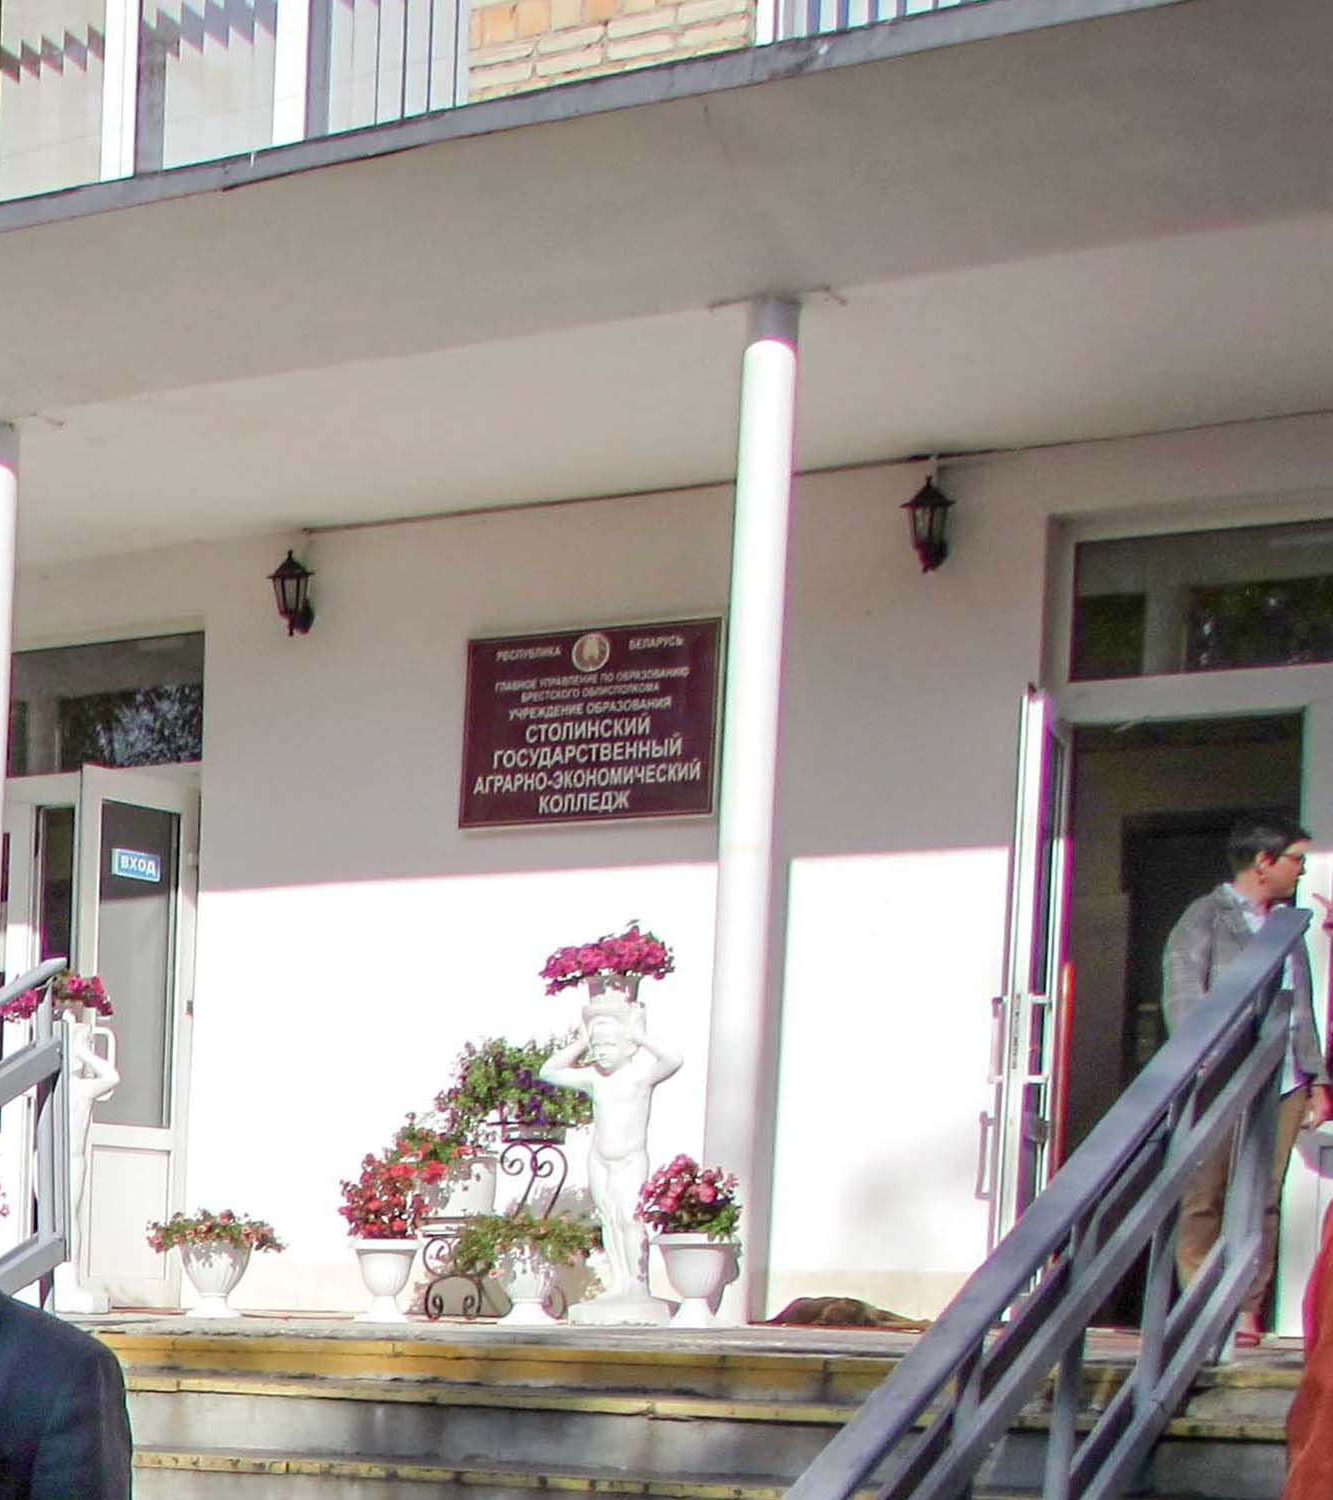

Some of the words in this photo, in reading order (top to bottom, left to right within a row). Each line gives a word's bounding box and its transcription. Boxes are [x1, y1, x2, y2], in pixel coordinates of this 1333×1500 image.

[495, 646, 562, 662] РЕСПУБЛИКА
[629, 637, 685, 651] БЕЛАРУСЬ
[600, 672, 614, 683] ПО
[508, 702, 584, 721] УЧРЕЖДЕНИЕ
[586, 695, 672, 715] ОБРАЗОВАНИЯ
[521, 689, 580, 703] БРЕСТСКОГО
[525, 711, 650, 743] СТОЛИНСКИЙ
[493, 733, 683, 769] ГОСУДАРСТВЕННЫЙ
[473, 759, 701, 795] АГРАРНО-ЭКОНОМИЧЕСКИЙ
[538, 789, 631, 815] КОЛЛЕДЖ
[120, 855, 156, 876] ВХОД
